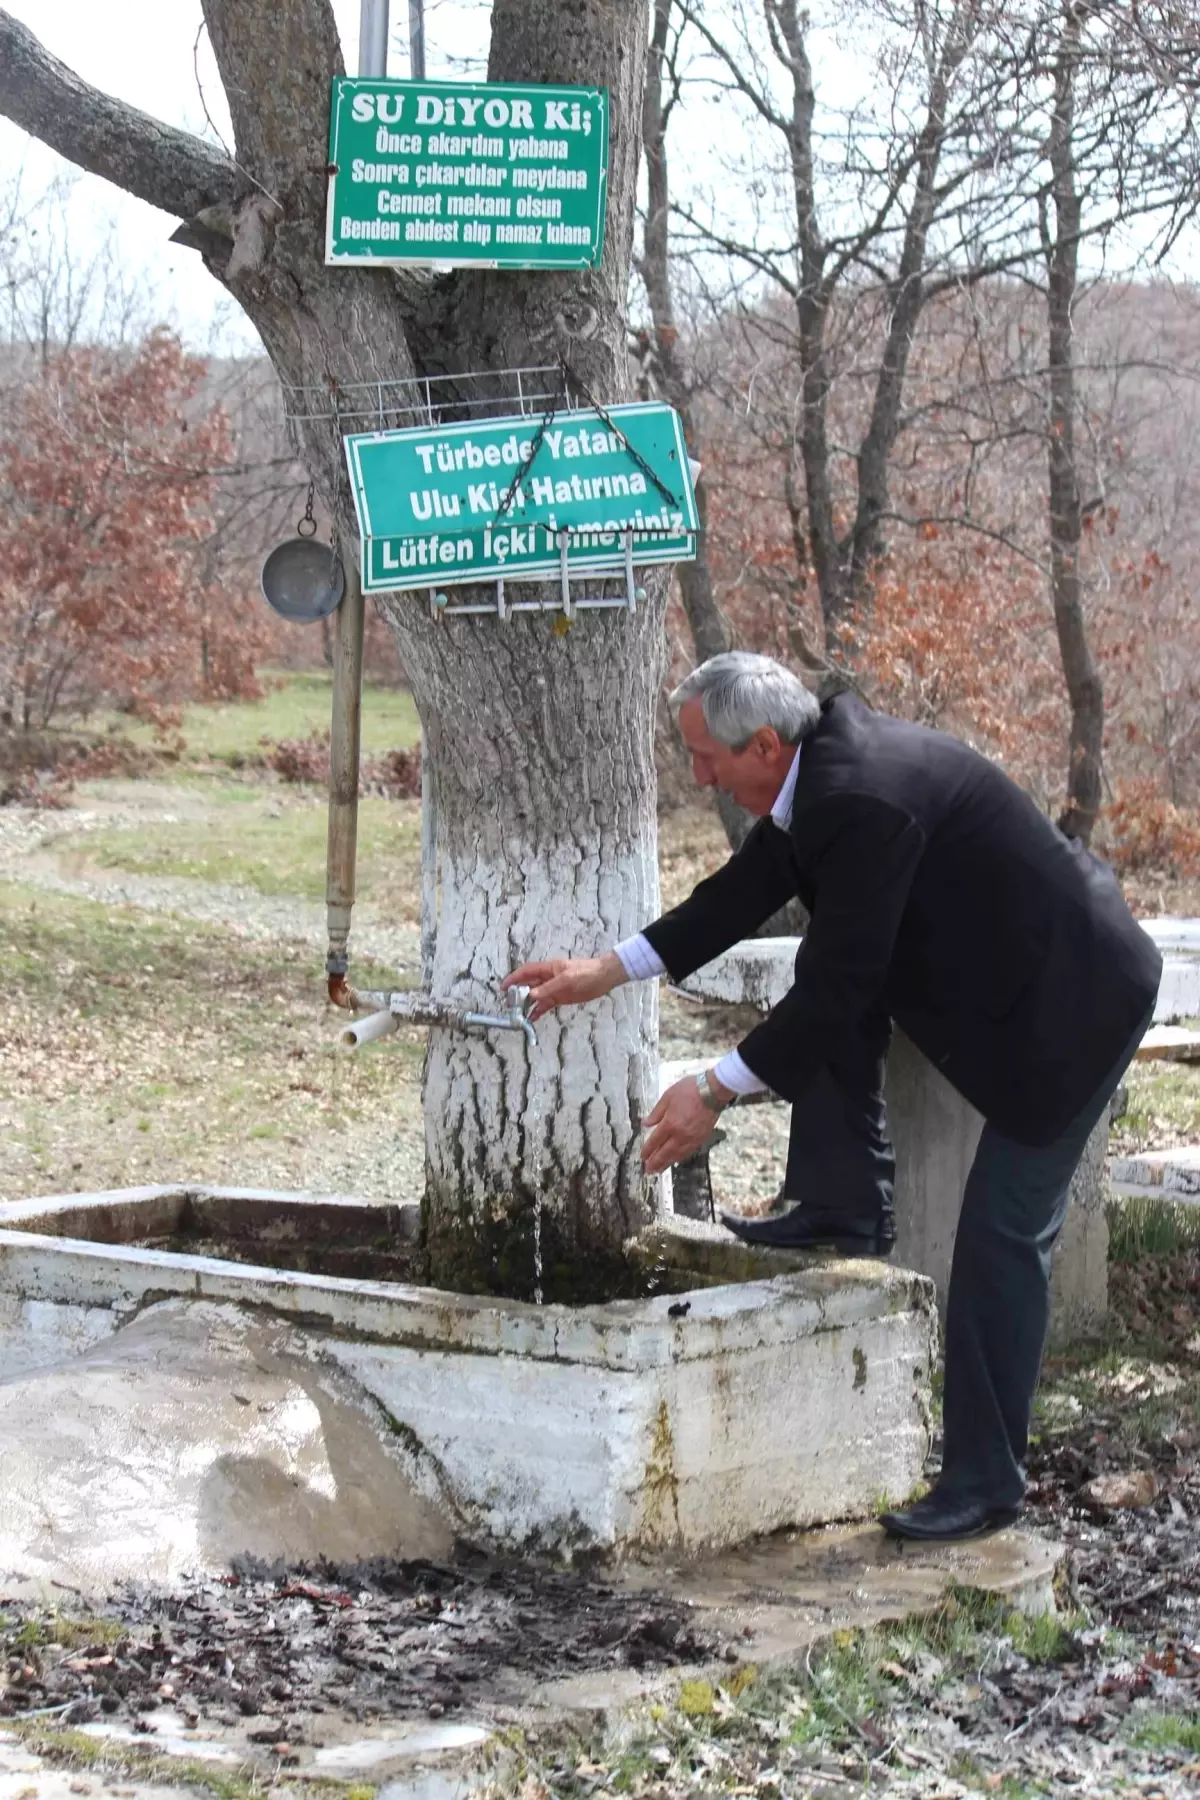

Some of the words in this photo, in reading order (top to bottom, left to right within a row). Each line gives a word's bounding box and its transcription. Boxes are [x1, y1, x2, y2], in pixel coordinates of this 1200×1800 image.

[352, 93, 404, 123] SU
[376, 126, 422, 154] Önce
[428, 132, 504, 157] akardım
[508, 134, 568, 161] yabana
[352, 159, 409, 184] Sonra
[415, 162, 507, 188] çıkardılar
[512, 166, 588, 192] meydana
[377, 190, 442, 215] Cennet
[447, 193, 511, 217] mekanı
[516, 195, 562, 218] olsun
[340, 216, 400, 241] Benden
[405, 218, 458, 242] abdest
[463, 220, 492, 246] alıp
[496, 224, 543, 244] namaz
[547, 223, 591, 245] kılana
[416, 435, 535, 474] Türbede
[543, 428, 626, 460] Yatan
[410, 488, 461, 521] Ulu
[531, 472, 647, 506] Hatırına
[383, 531, 473, 570] Lütfen
